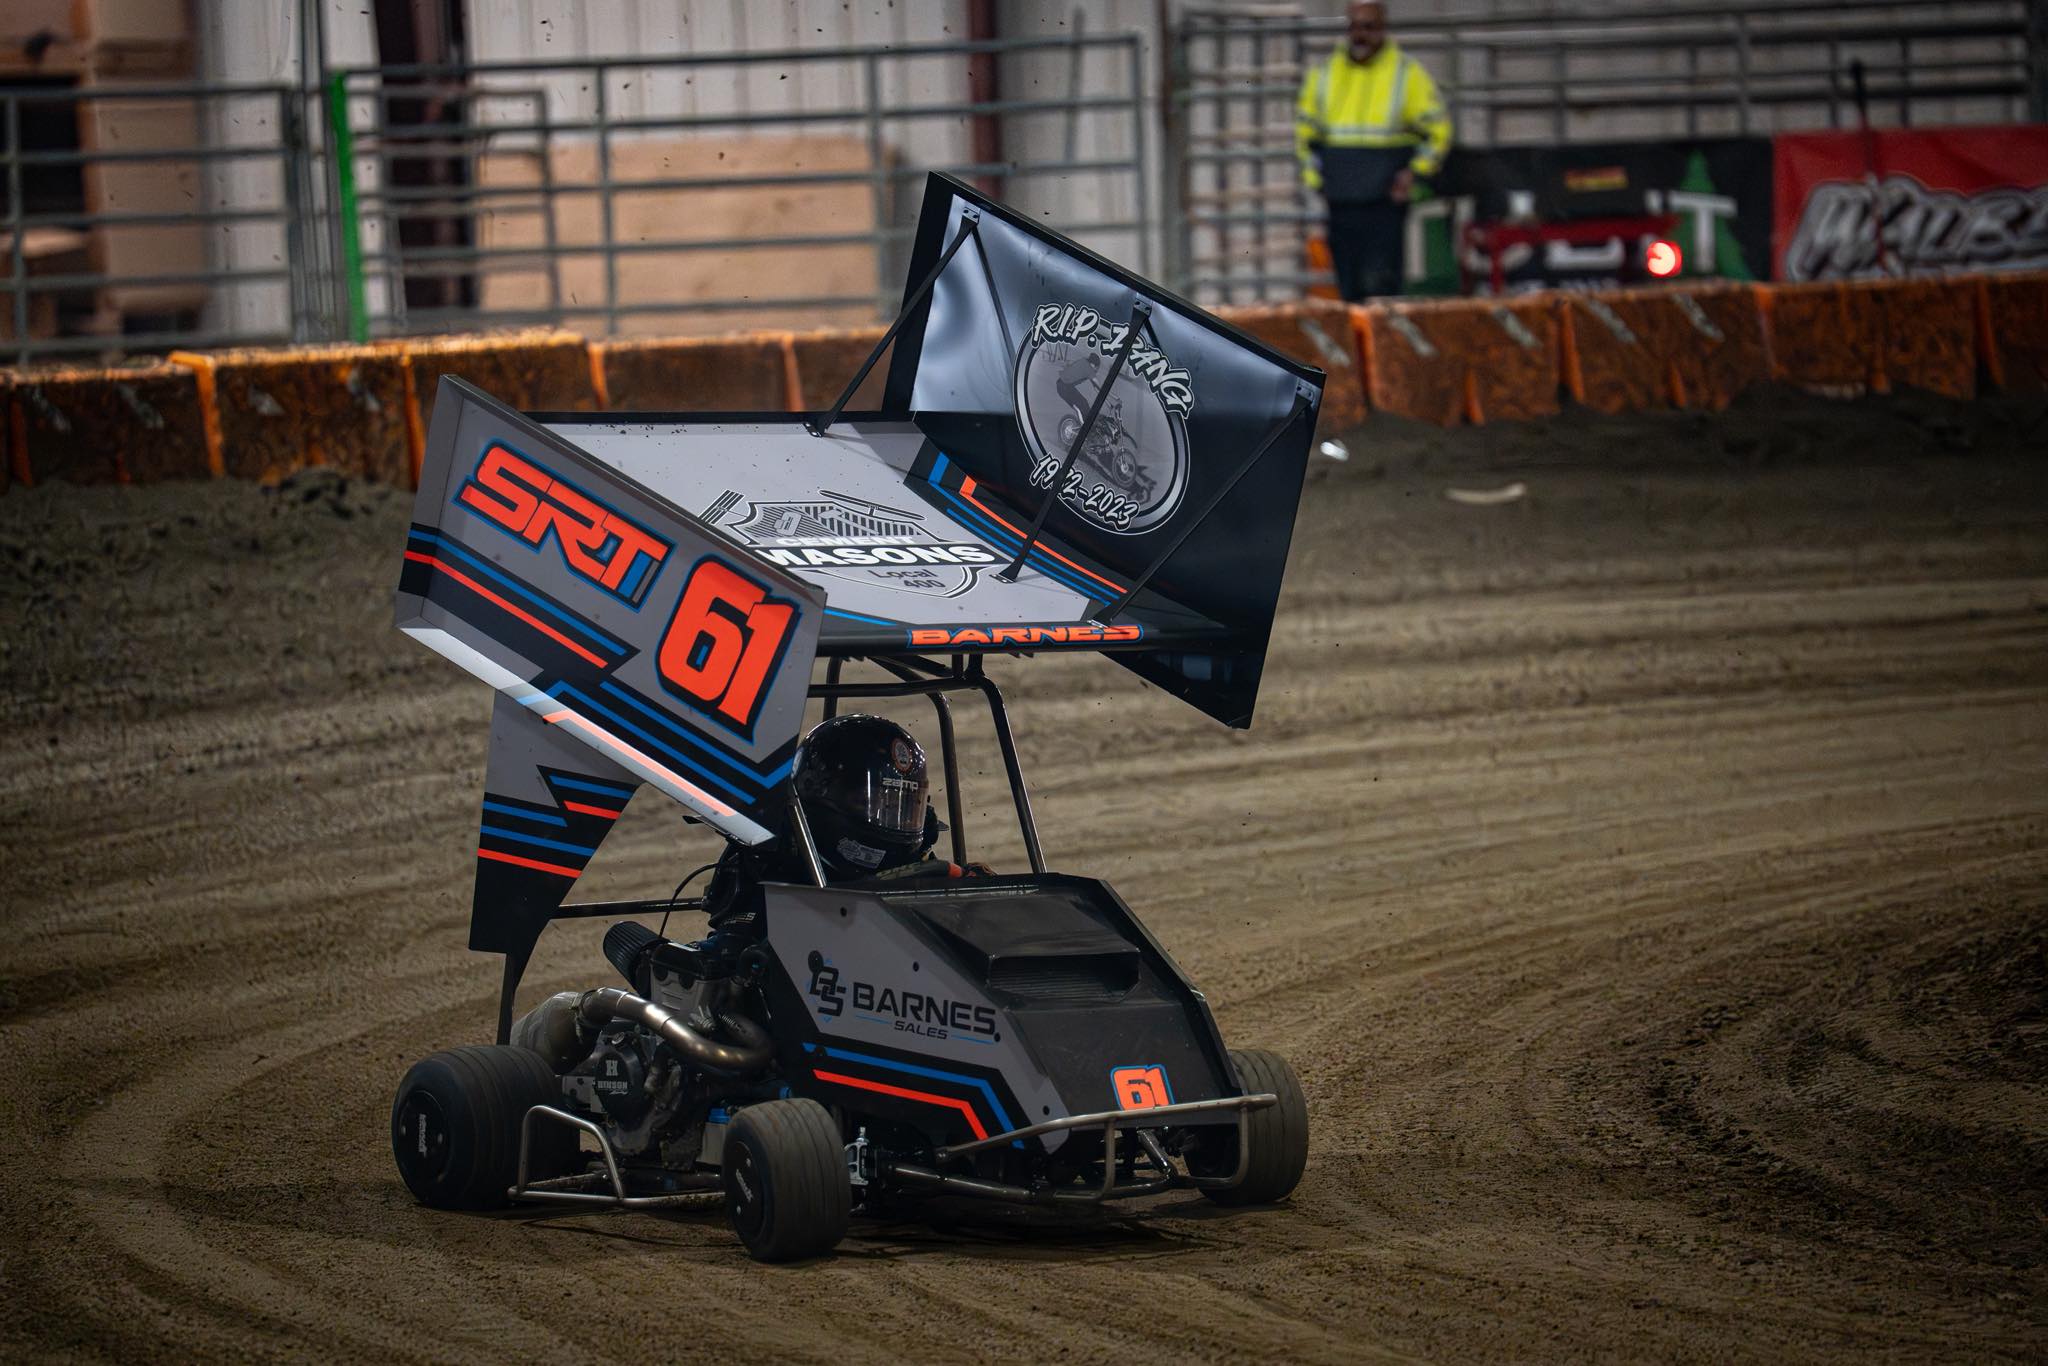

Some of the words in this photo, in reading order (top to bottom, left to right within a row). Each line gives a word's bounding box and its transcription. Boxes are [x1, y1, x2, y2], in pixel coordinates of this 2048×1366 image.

[1032, 304, 1098, 345] R.I.P.
[1031, 454, 1139, 527] 192-2023
[775, 535, 917, 548] CEMENT
[754, 544, 996, 567] MASONS
[868, 567, 939, 580] Local
[902, 578, 946, 589] 400
[655, 558, 799, 736] 61
[909, 624, 1142, 647] BARNES
[852, 981, 996, 1036] BARNES
[893, 1019, 949, 1040] SALES
[1113, 1067, 1171, 1111] 61
